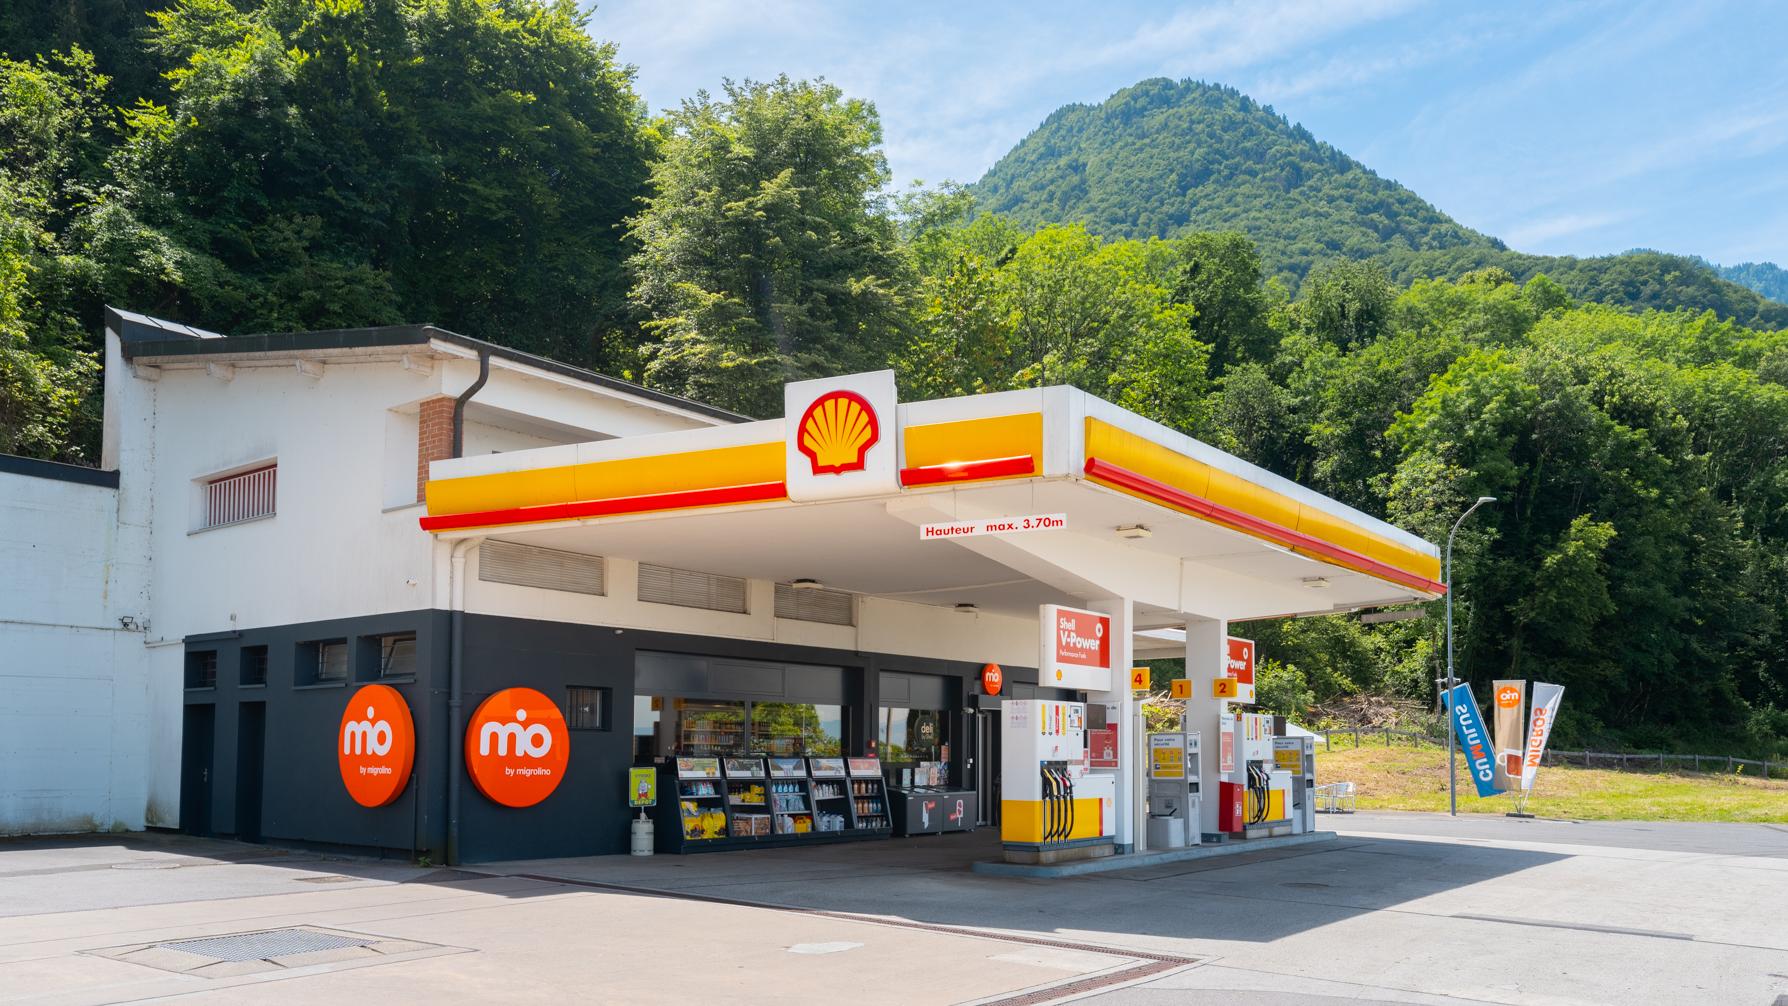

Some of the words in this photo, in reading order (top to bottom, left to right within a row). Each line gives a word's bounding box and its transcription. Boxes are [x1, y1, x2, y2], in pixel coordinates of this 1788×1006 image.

[925, 524, 975, 537] Hauteur
[986, 520, 1018, 532] max.
[1022, 517, 1063, 529] 3.70m
[1059, 617, 1076, 630] Shell
[1059, 630, 1100, 651] V-Power
[1226, 655, 1246, 671] Power
[985, 669, 999, 683] mio
[1134, 673, 1143, 685] 4
[1178, 684, 1183, 695] 1
[1218, 682, 1226, 694] 2
[344, 705, 393, 756] mio
[479, 708, 552, 758] mio
[920, 722, 934, 734] deli
[359, 765, 367, 775] by
[367, 765, 392, 775] migrolino
[505, 767, 515, 776] by
[516, 766, 551, 776] migrolino
